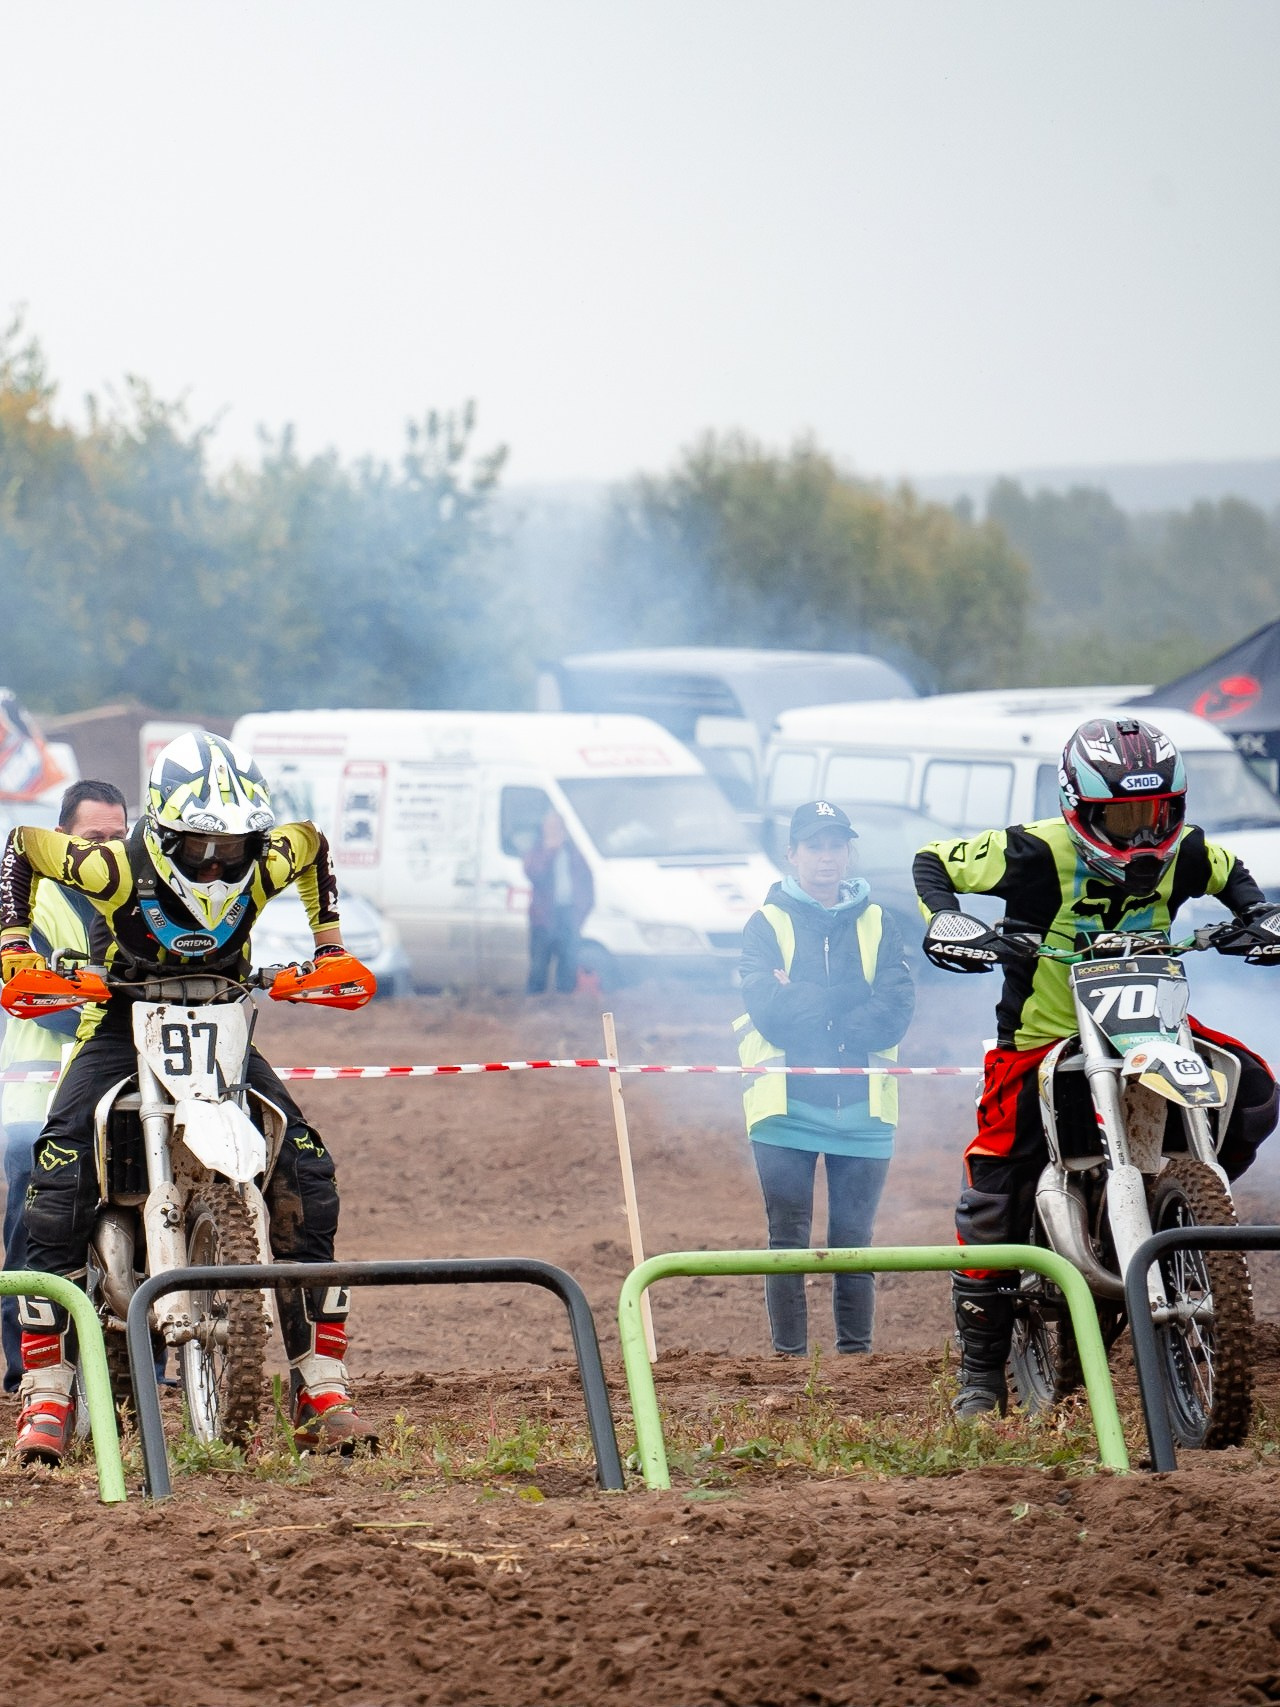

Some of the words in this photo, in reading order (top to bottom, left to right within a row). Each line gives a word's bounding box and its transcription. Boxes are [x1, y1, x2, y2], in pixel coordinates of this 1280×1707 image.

[1126, 776, 1159, 789] SHOEI
[816, 802, 836, 817] LA
[176, 940, 212, 948] ORTEMA
[929, 942, 999, 961] ACERBIS
[161, 1023, 218, 1075] 97
